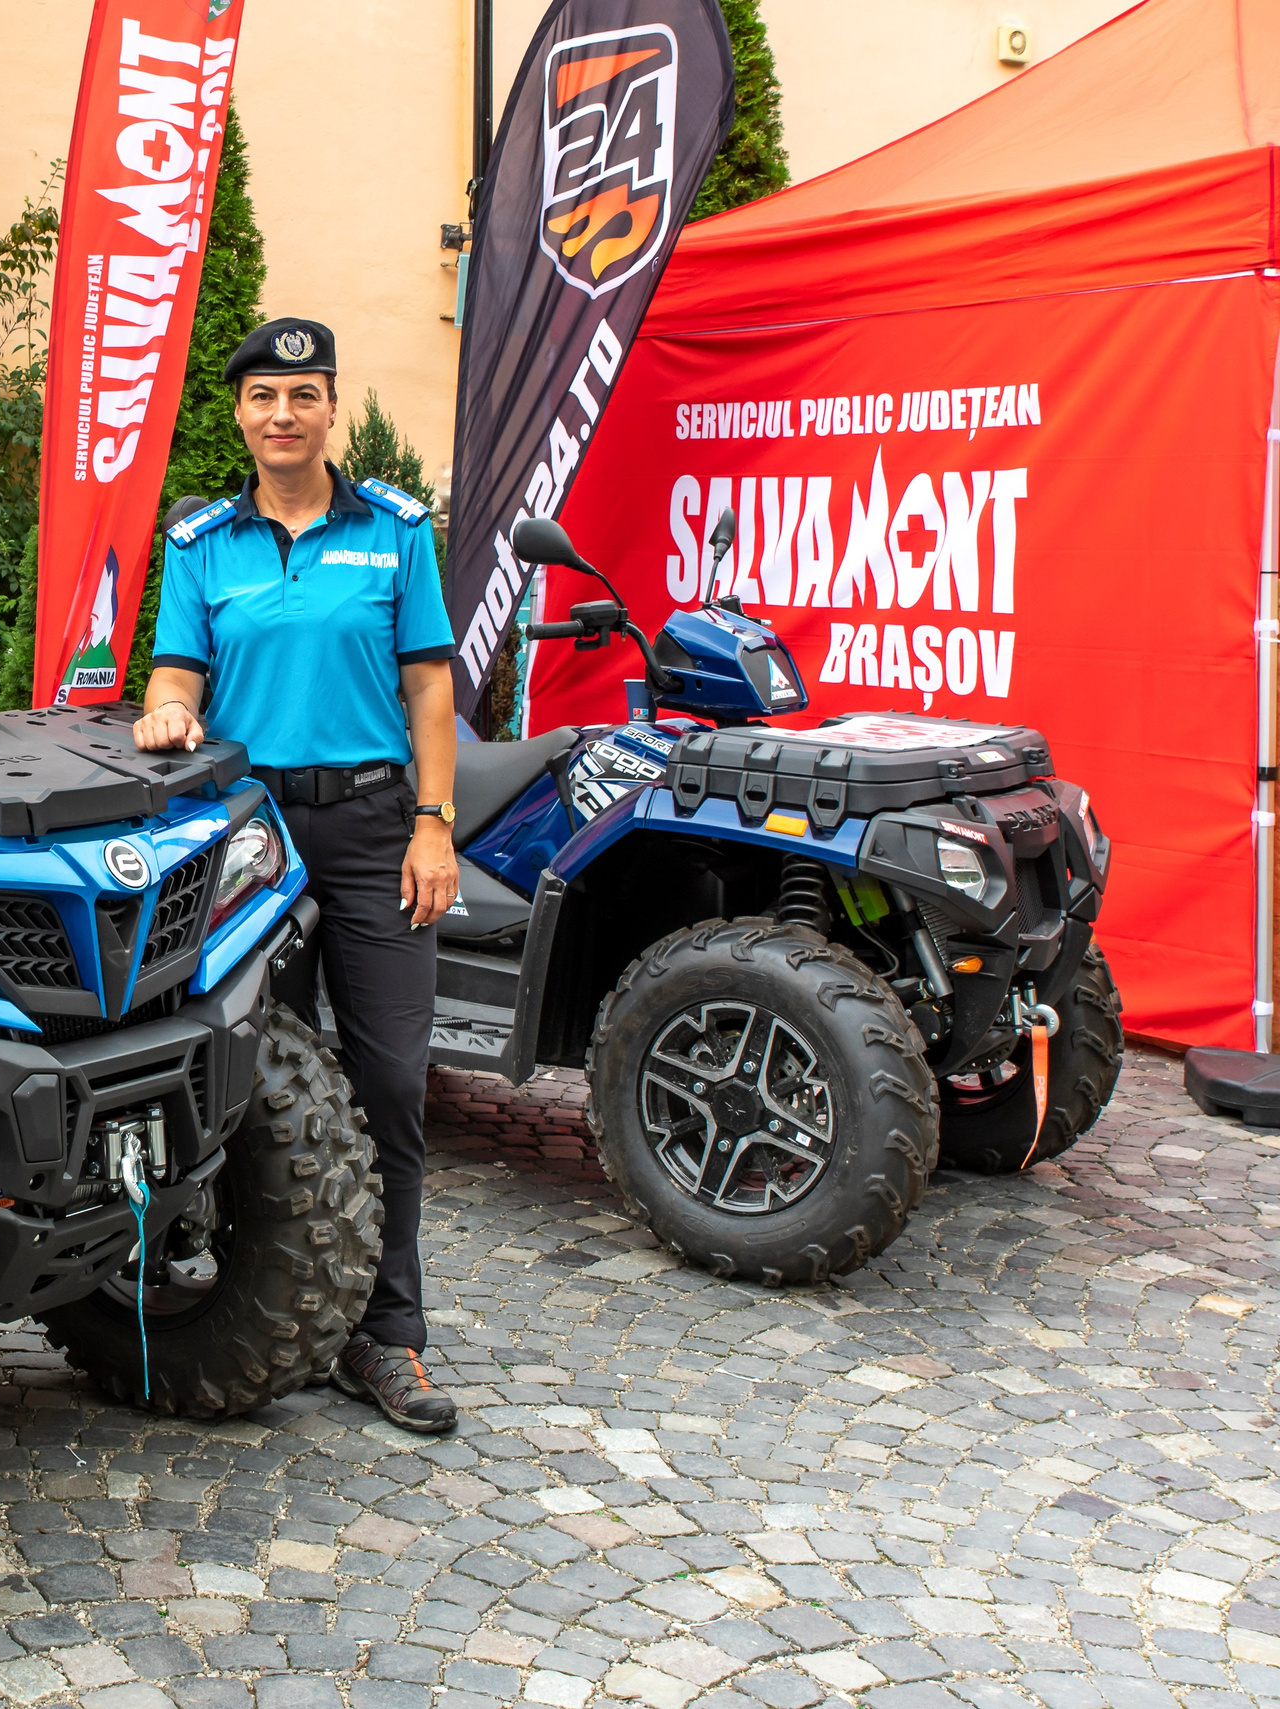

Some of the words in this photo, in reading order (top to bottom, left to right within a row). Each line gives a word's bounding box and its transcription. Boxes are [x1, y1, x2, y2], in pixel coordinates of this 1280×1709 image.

[552, 76, 663, 198] 24
[92, 18, 201, 483] SALVAMONT
[84, 254, 104, 332] JUDEȚEAN
[80, 333, 97, 394] PUBLIC
[74, 396, 94, 481] SERVICIUL
[675, 400, 794, 440] SERVICIUL
[799, 393, 893, 437] PUBLIC
[897, 383, 1041, 441] JUDEȚEAN
[666, 443, 1028, 614] SALVAMONT
[819, 622, 1016, 711] BRAȘOV
[590, 741, 662, 780] 1000
[625, 727, 673, 754] SPORT
